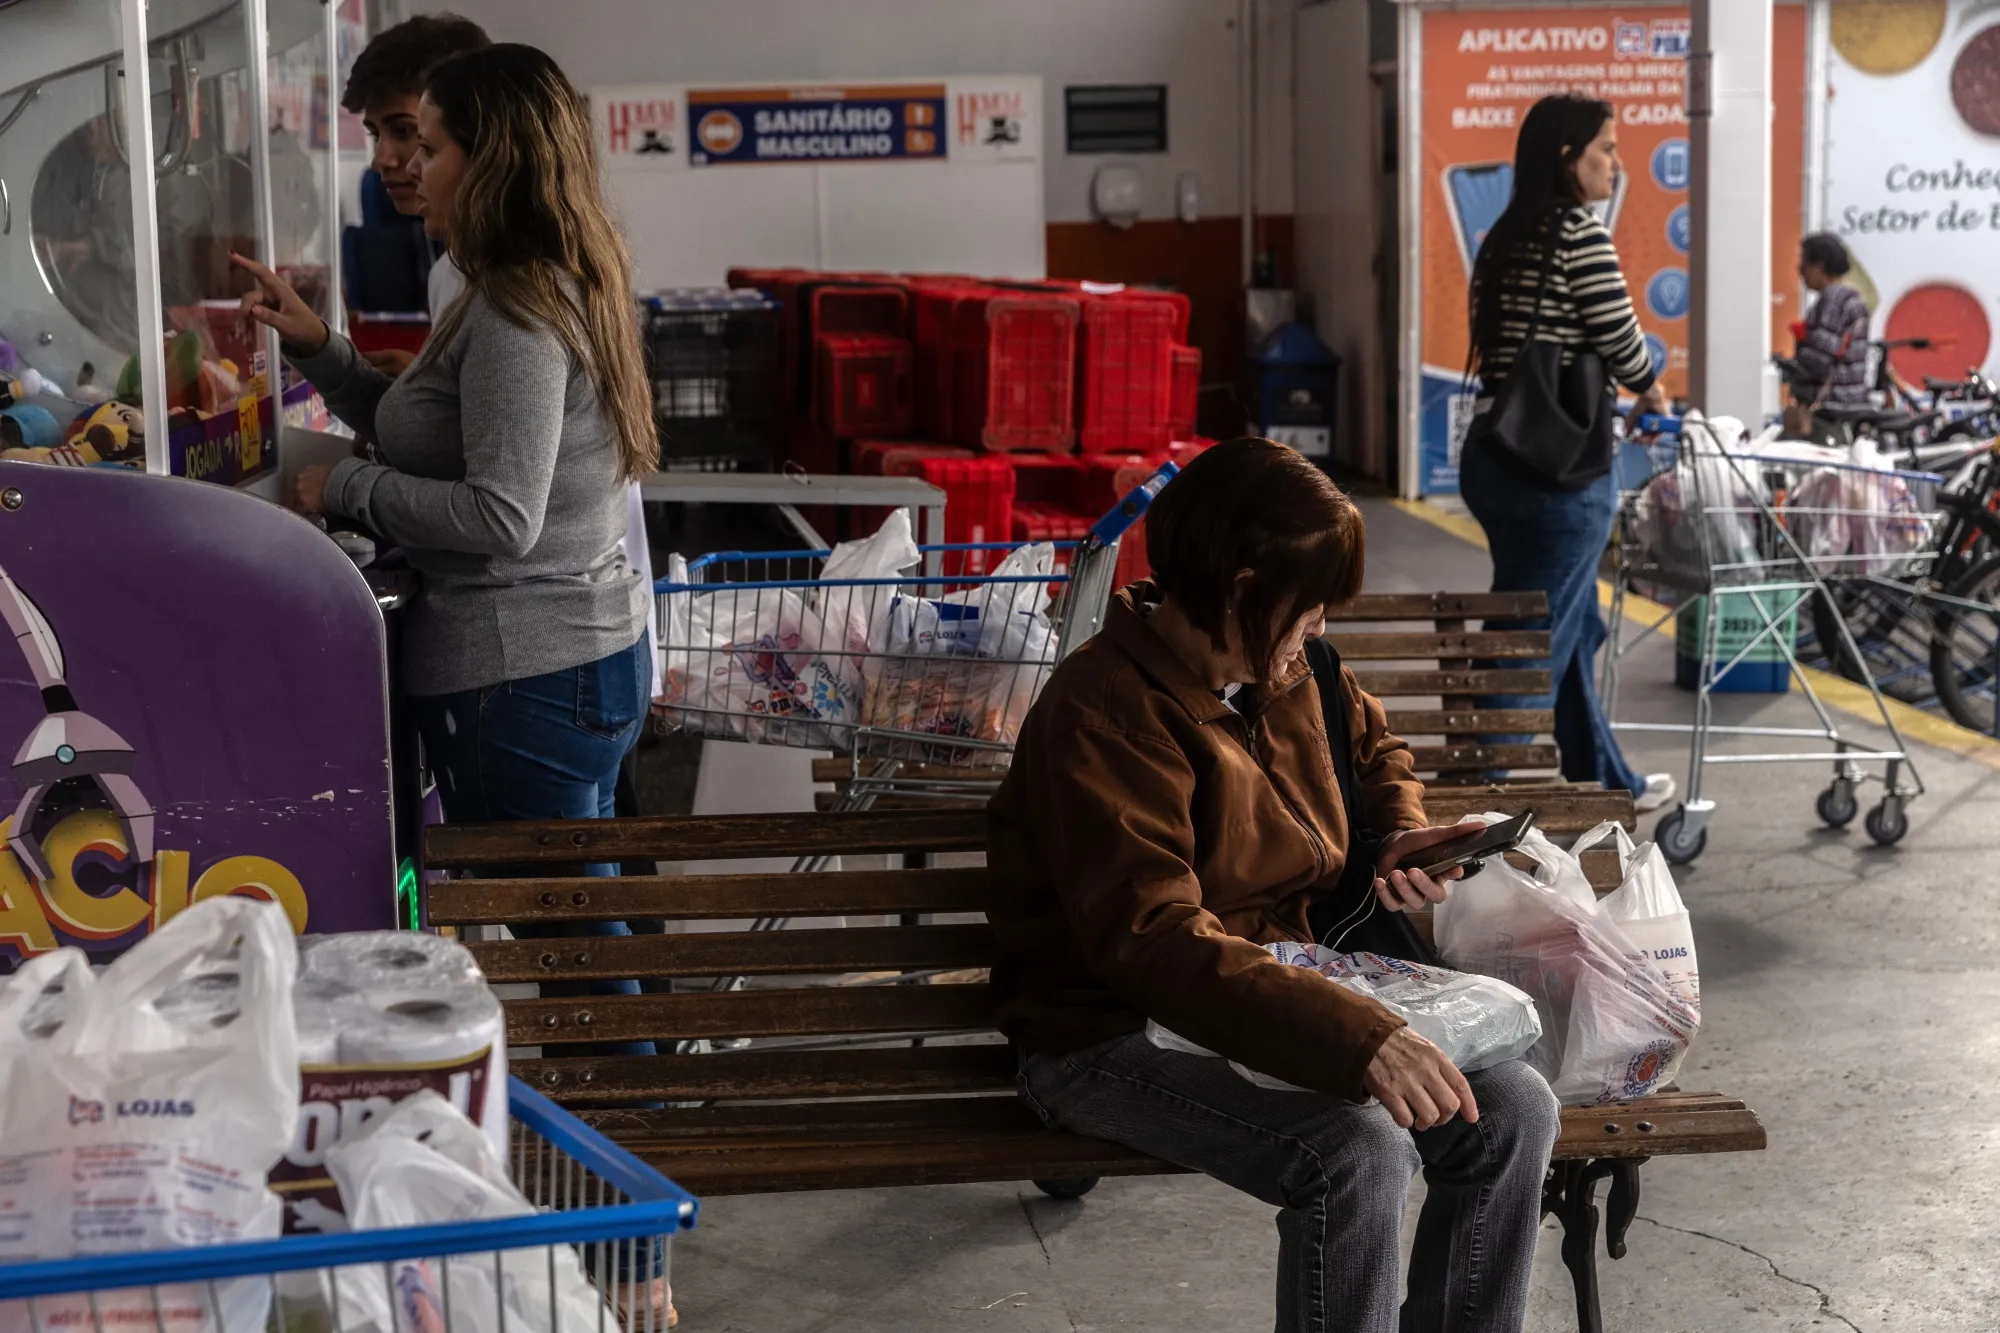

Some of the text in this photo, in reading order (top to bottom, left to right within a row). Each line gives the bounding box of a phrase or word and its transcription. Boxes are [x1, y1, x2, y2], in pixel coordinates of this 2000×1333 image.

[1458, 27, 1608, 52] APLICATIVO
[1511, 64, 1606, 80] VANTAGENS
[1599, 81, 1654, 98] PALMA
[754, 101, 893, 134] SANITÁRIO
[1452, 103, 1690, 129] BAIXE CADA
[756, 133, 892, 158] MASCULINO
[1838, 204, 1931, 236] Setor
[1936, 199, 1985, 232] de
[185, 437, 224, 480] JOGADA
[1654, 946, 1688, 960] LOJAS
[308, 1077, 422, 1098] Papel Higiênico
[116, 1099, 196, 1118] LOJAS
